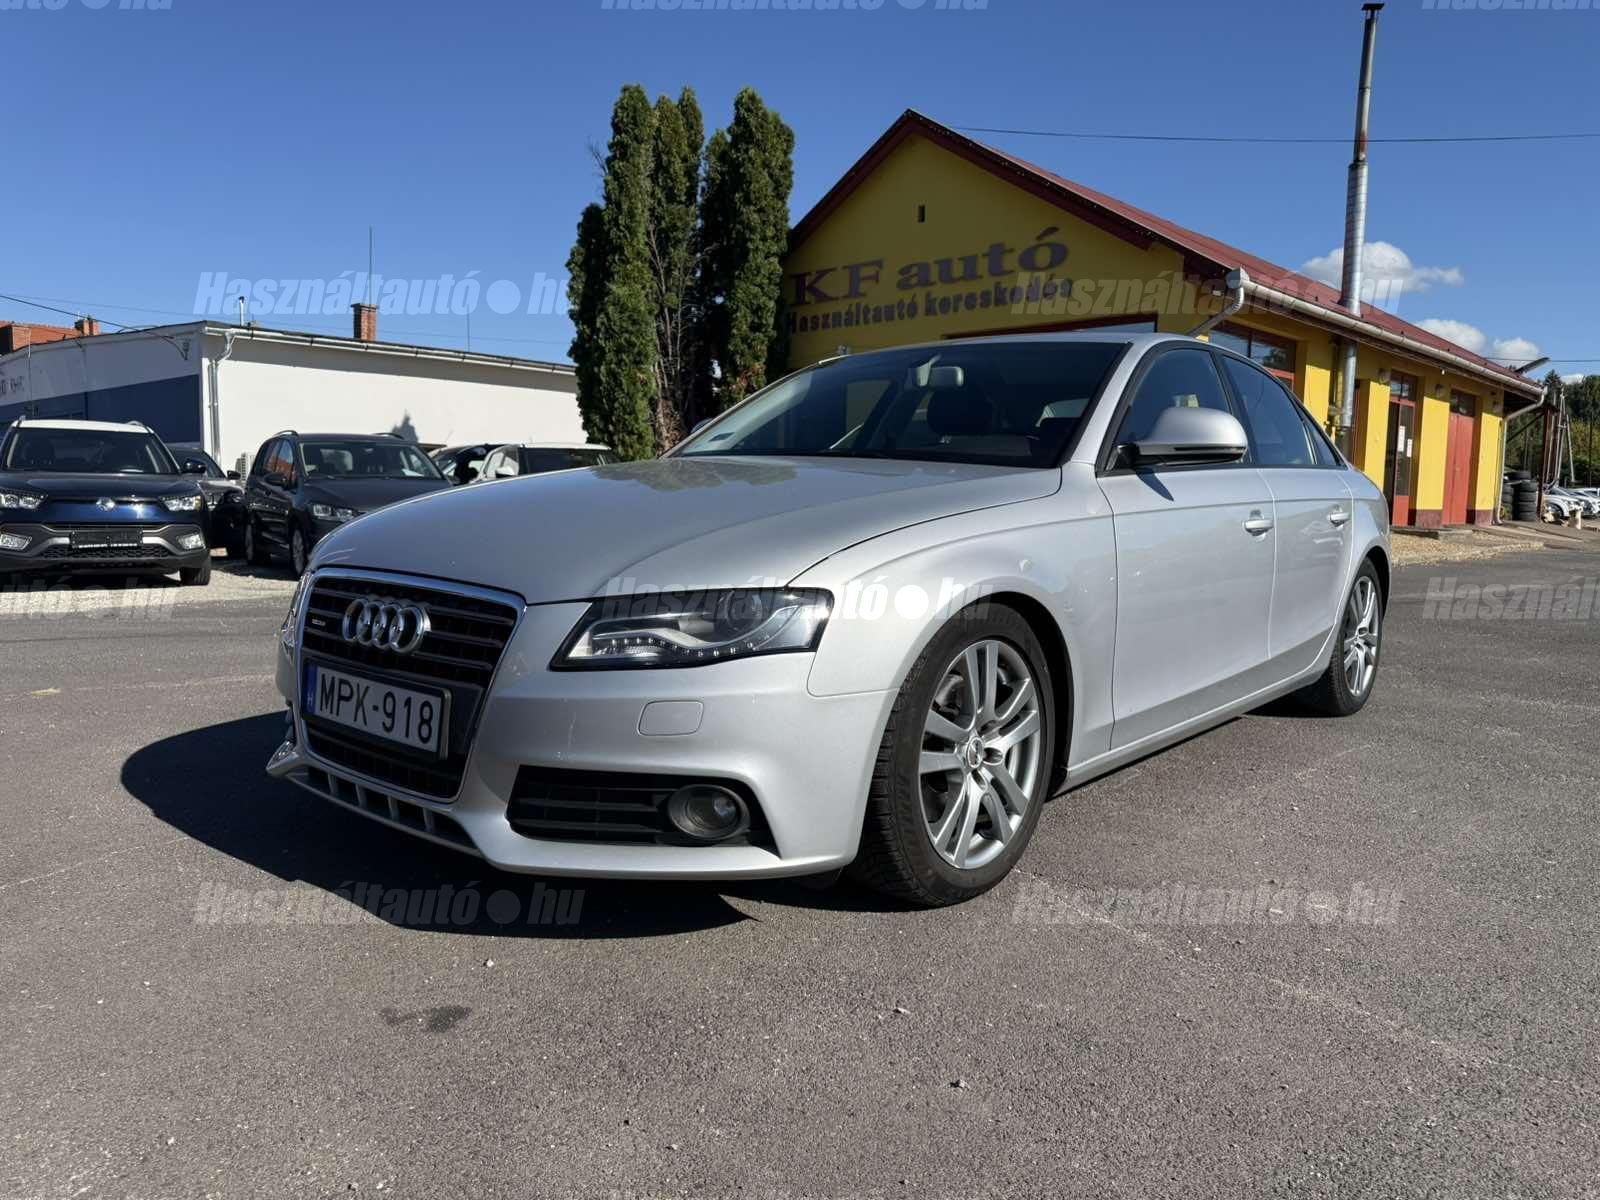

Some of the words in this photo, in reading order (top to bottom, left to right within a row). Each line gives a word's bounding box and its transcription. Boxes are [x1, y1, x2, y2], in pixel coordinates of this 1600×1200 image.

[788, 258, 884, 305] KF
[896, 226, 1069, 291] autó
[786, 293, 918, 335] Használtautó
[924, 272, 1072, 317] kereskedés
[319, 673, 434, 744] MPK-918
